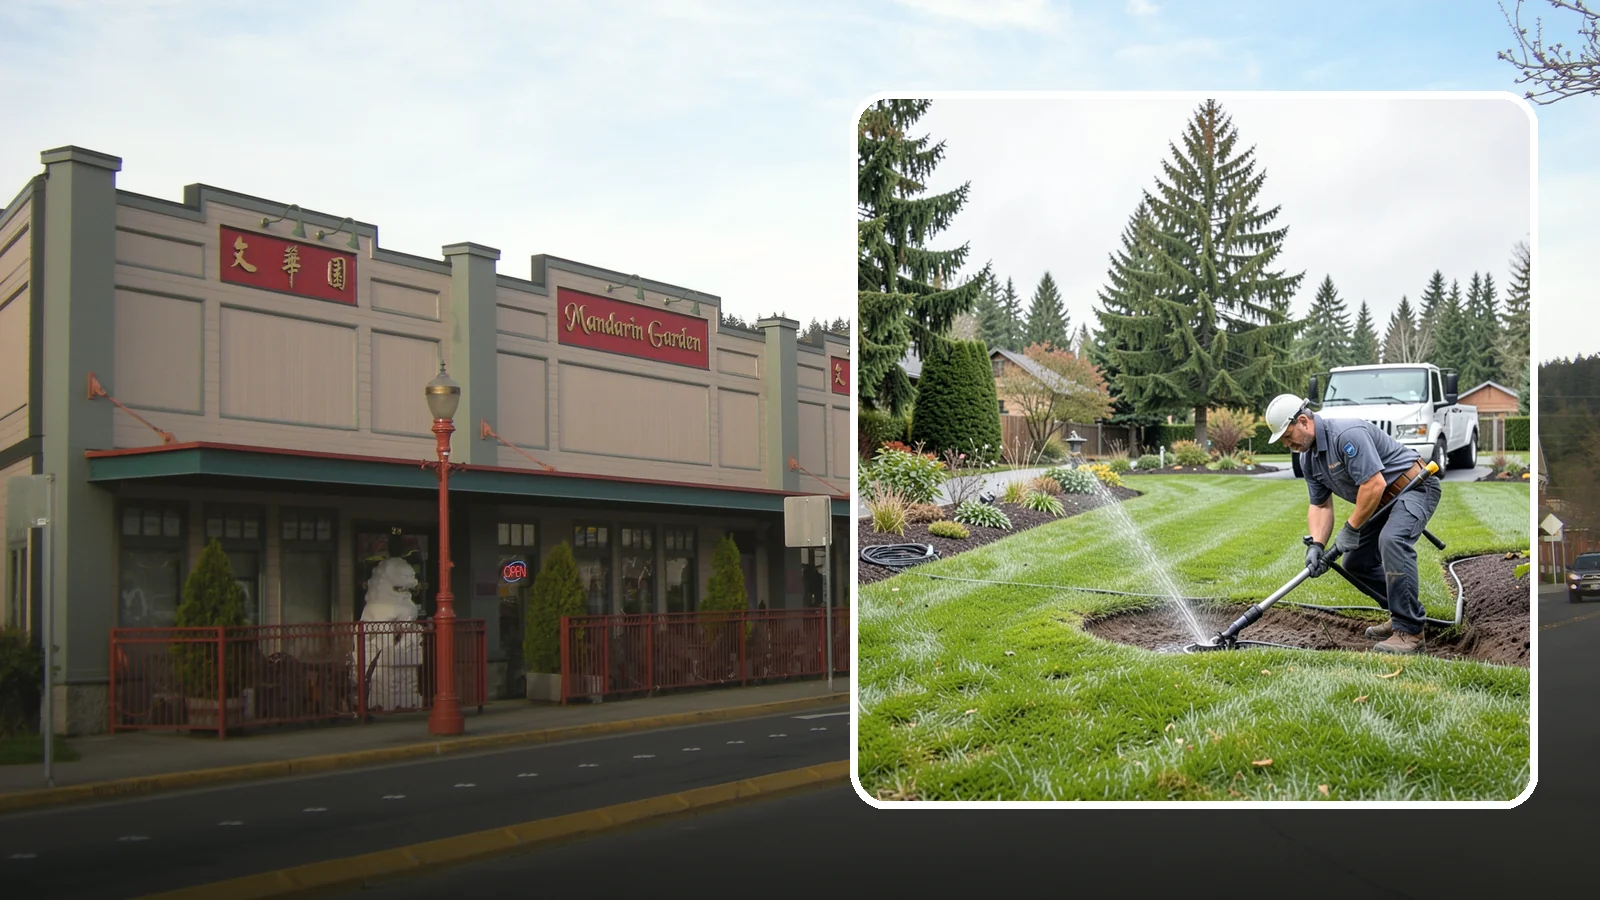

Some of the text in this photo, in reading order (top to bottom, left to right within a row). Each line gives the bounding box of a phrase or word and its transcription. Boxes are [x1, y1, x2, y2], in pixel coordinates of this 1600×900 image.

[230, 236, 347, 291] 文華園
[564, 302, 702, 352] Mandarin Garden
[503, 565, 527, 578] OPEN
